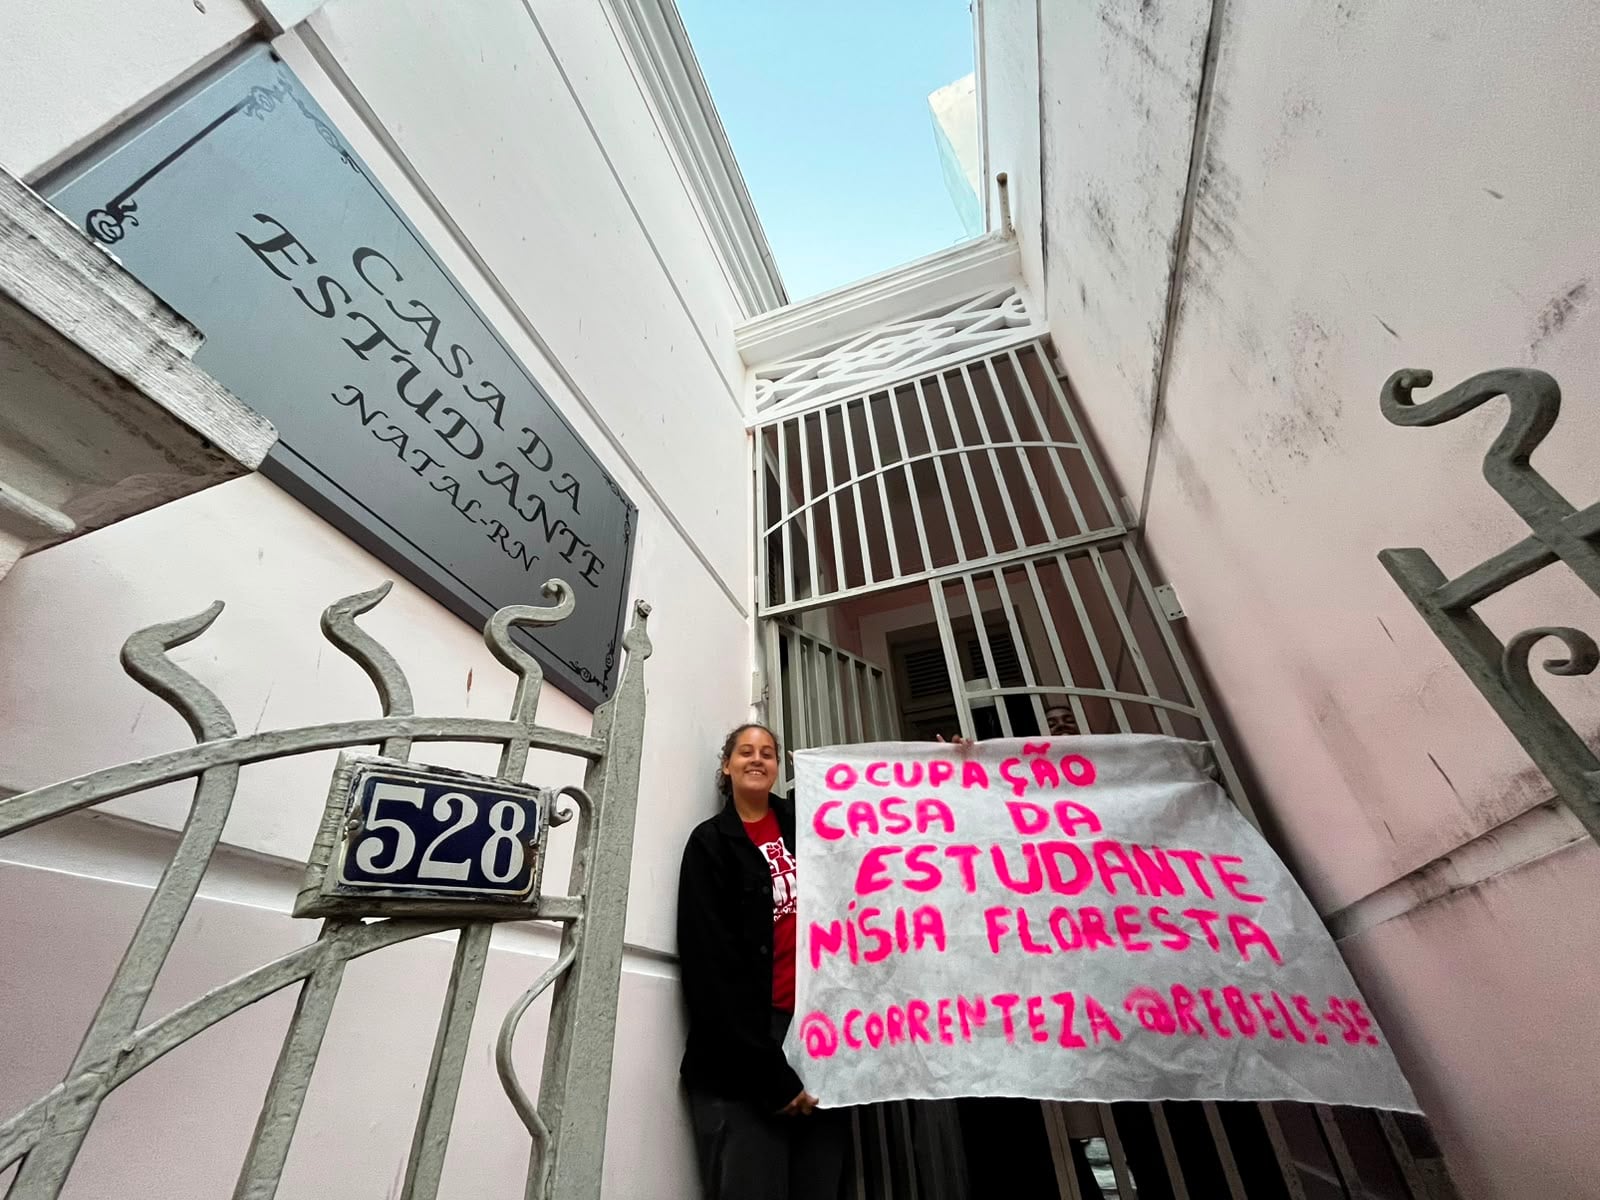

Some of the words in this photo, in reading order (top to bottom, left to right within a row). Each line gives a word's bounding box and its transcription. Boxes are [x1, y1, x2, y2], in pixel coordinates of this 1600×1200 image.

[235, 213, 605, 588] ESTUDANTE
[352, 246, 505, 431] CASA
[517, 426, 581, 515] DA
[331, 384, 540, 572] NATAL-RN
[824, 742, 1098, 798] OCUPAÇÃO
[356, 782, 526, 883] 528
[811, 797, 956, 843] CASA
[1004, 799, 1104, 839] DA
[853, 838, 1267, 905] ESTUDANTE
[808, 901, 948, 971] NÍSIA
[983, 903, 1283, 965] FLORESTA
[800, 991, 1124, 1060] @CORRENTEZA
